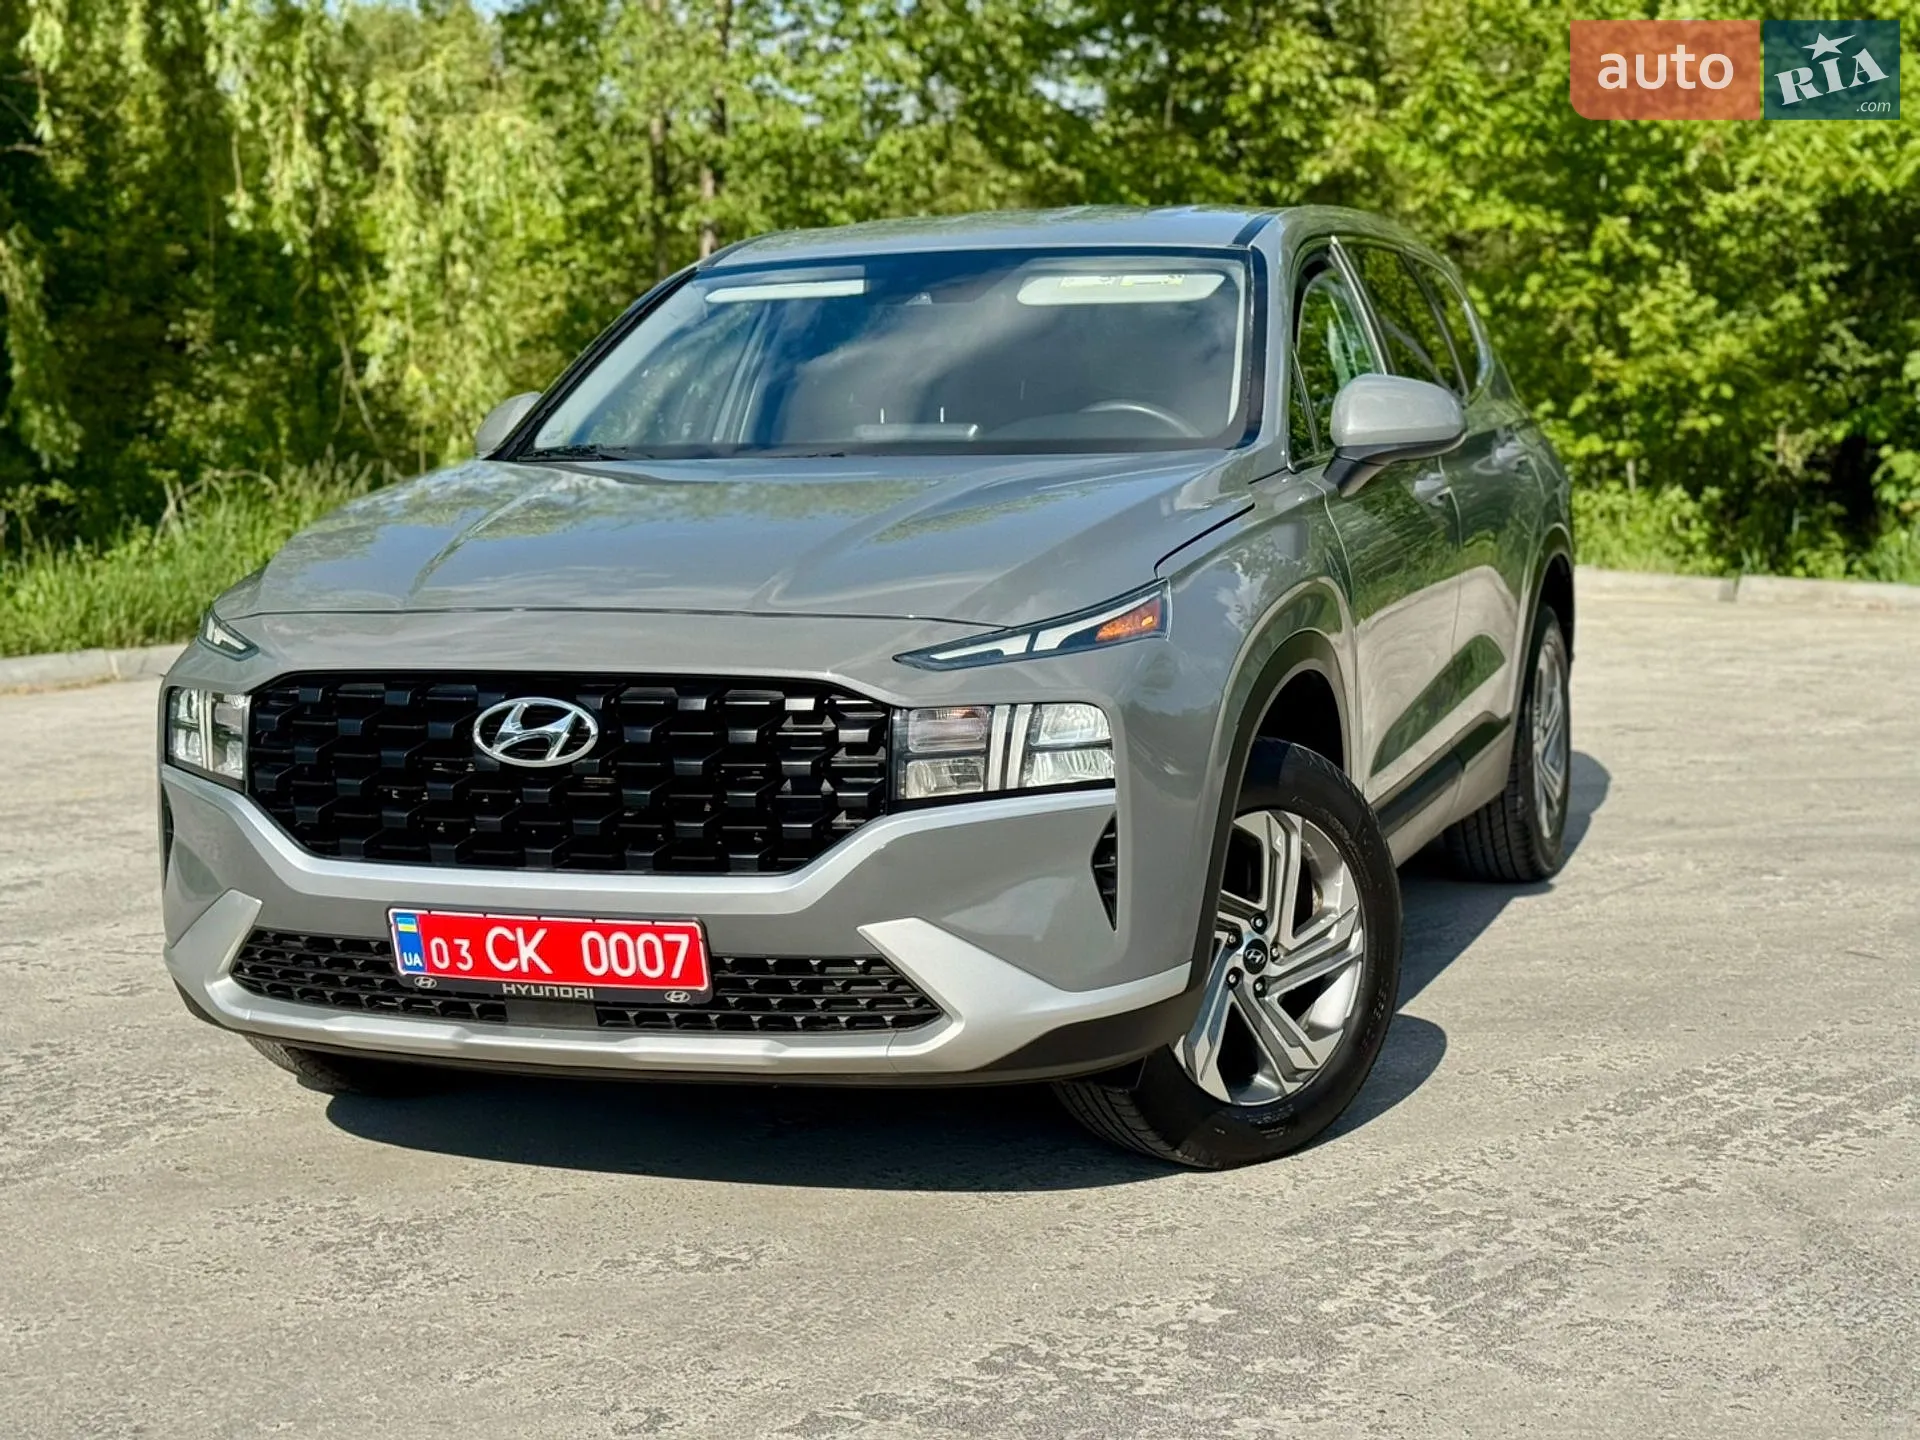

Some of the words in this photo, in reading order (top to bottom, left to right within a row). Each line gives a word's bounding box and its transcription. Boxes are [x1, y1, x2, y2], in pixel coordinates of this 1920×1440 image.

[403, 951, 423, 968] UA
[430, 936, 474, 971] 03
[484, 926, 554, 975] CK
[580, 930, 690, 980] 0007
[502, 983, 595, 1000] HYUNDAI
